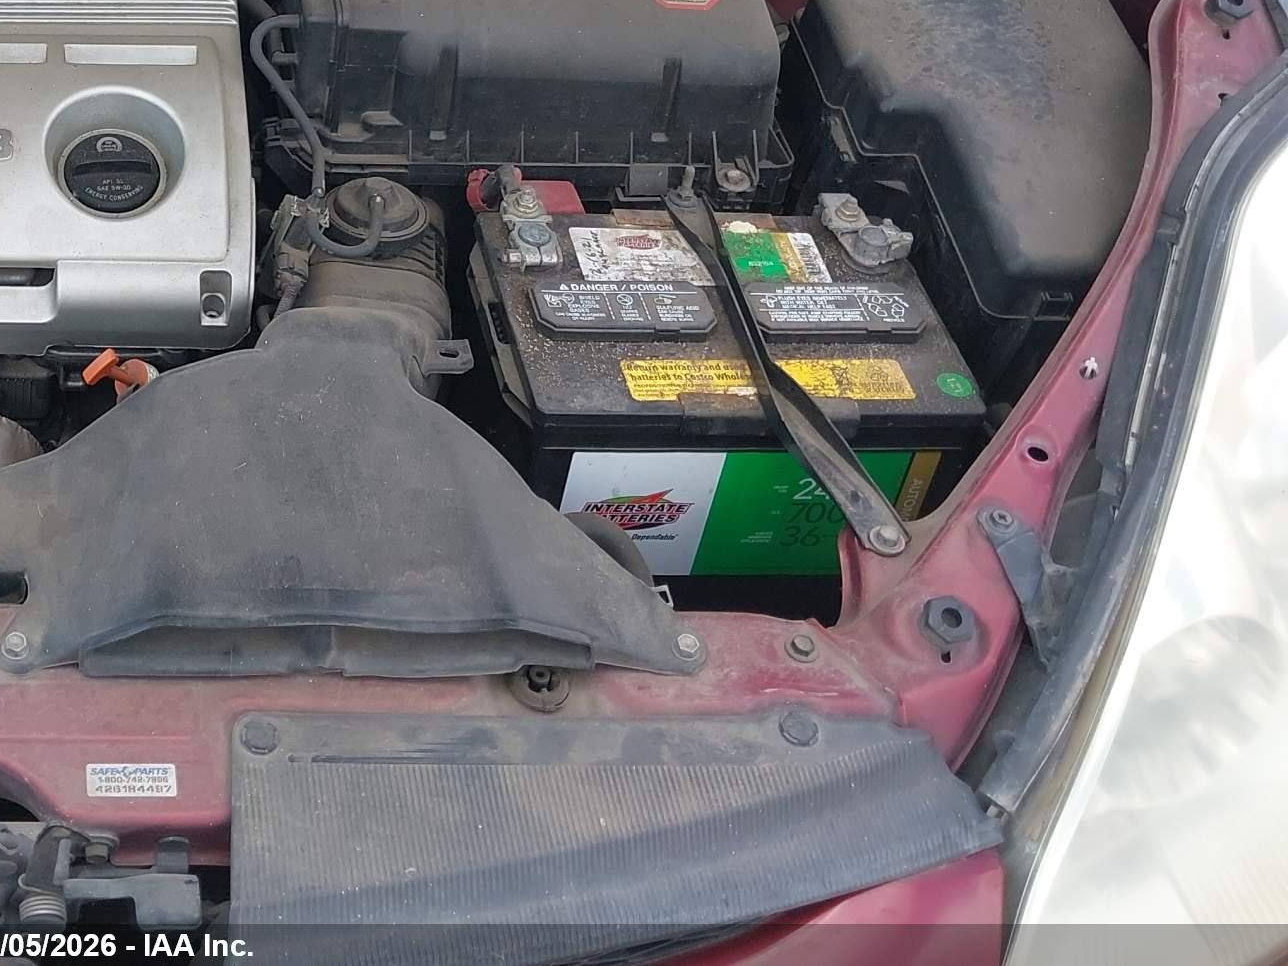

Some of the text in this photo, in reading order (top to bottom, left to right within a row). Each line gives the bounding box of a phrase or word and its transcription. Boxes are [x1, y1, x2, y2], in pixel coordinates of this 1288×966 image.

[84, 186, 107, 200] ENERGY
[570, 283, 619, 291] DANGER
[629, 283, 674, 291] POISON
[627, 364, 658, 372] Return
[661, 365, 702, 373] warranty
[704, 363, 722, 371] and
[583, 503, 688, 513] INTERSTATE
[602, 514, 678, 523] ATTERIES
